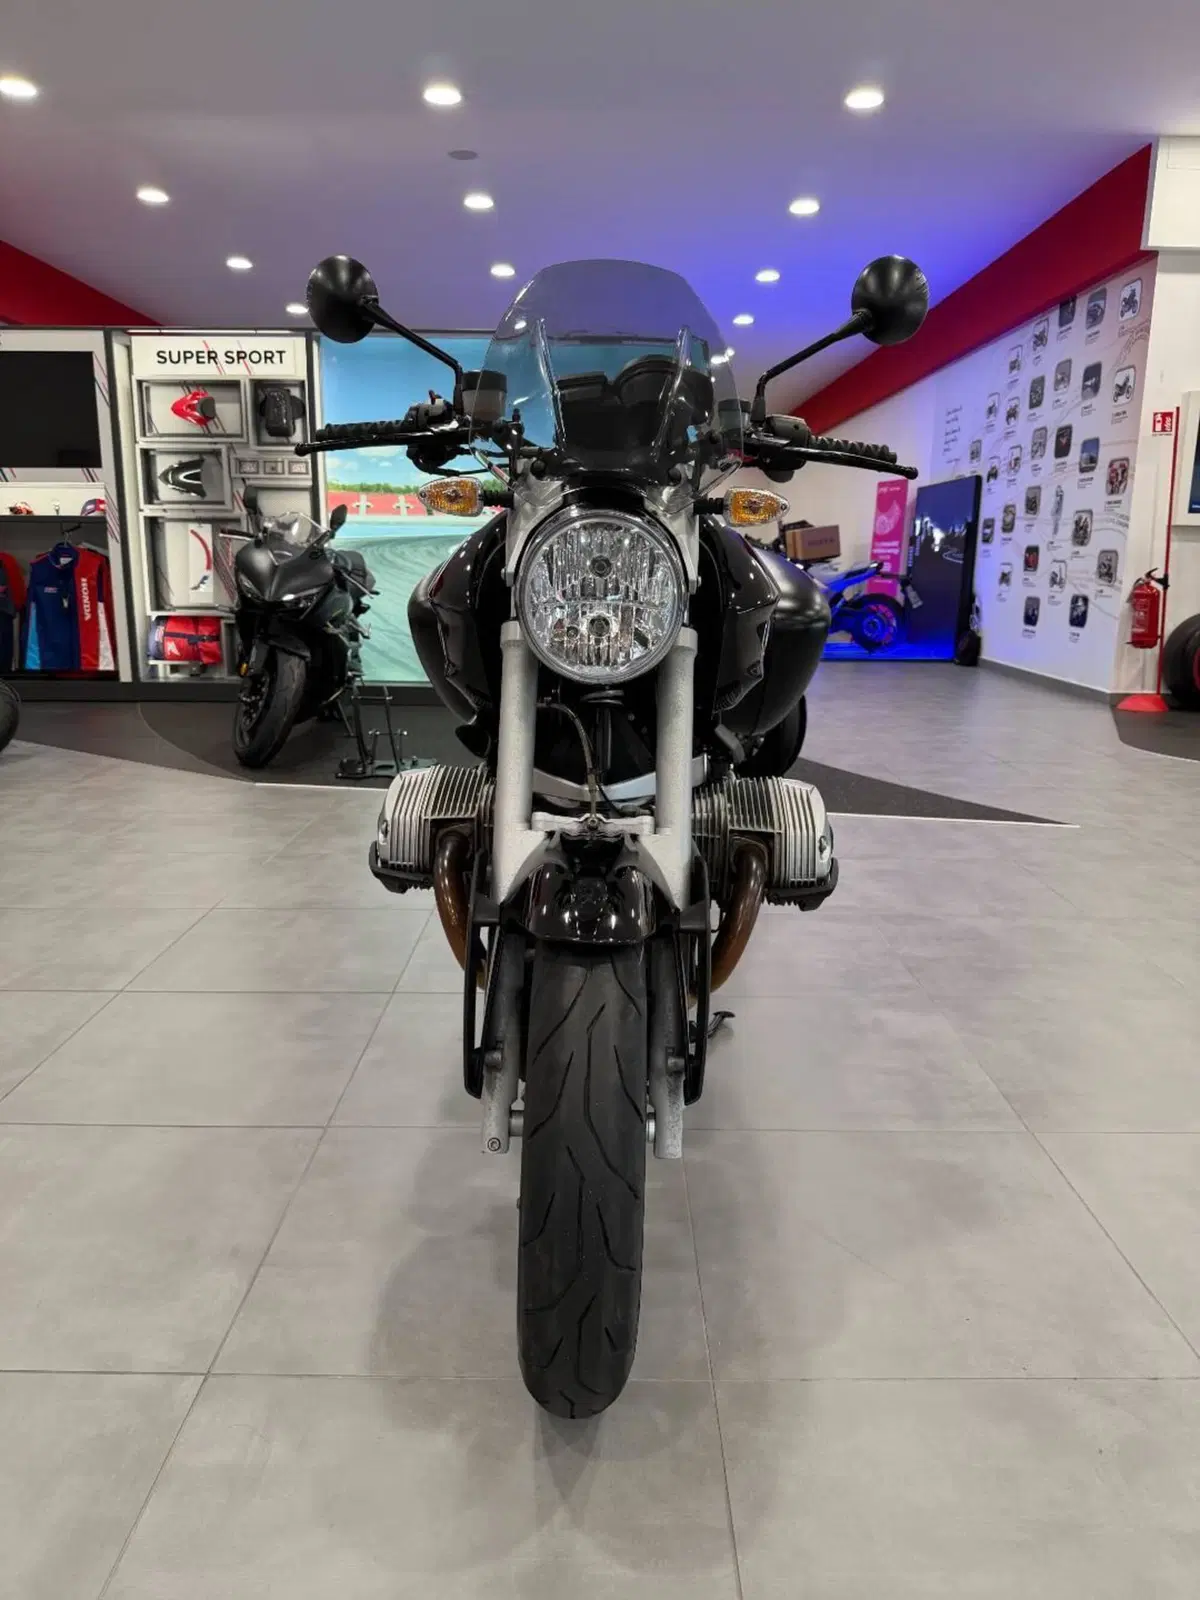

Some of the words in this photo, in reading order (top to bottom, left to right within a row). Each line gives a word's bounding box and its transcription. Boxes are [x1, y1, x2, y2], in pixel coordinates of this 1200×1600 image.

[156, 350, 218, 365] SUPER
[224, 350, 286, 365] SPORT
[81, 577, 92, 621] HONDA
